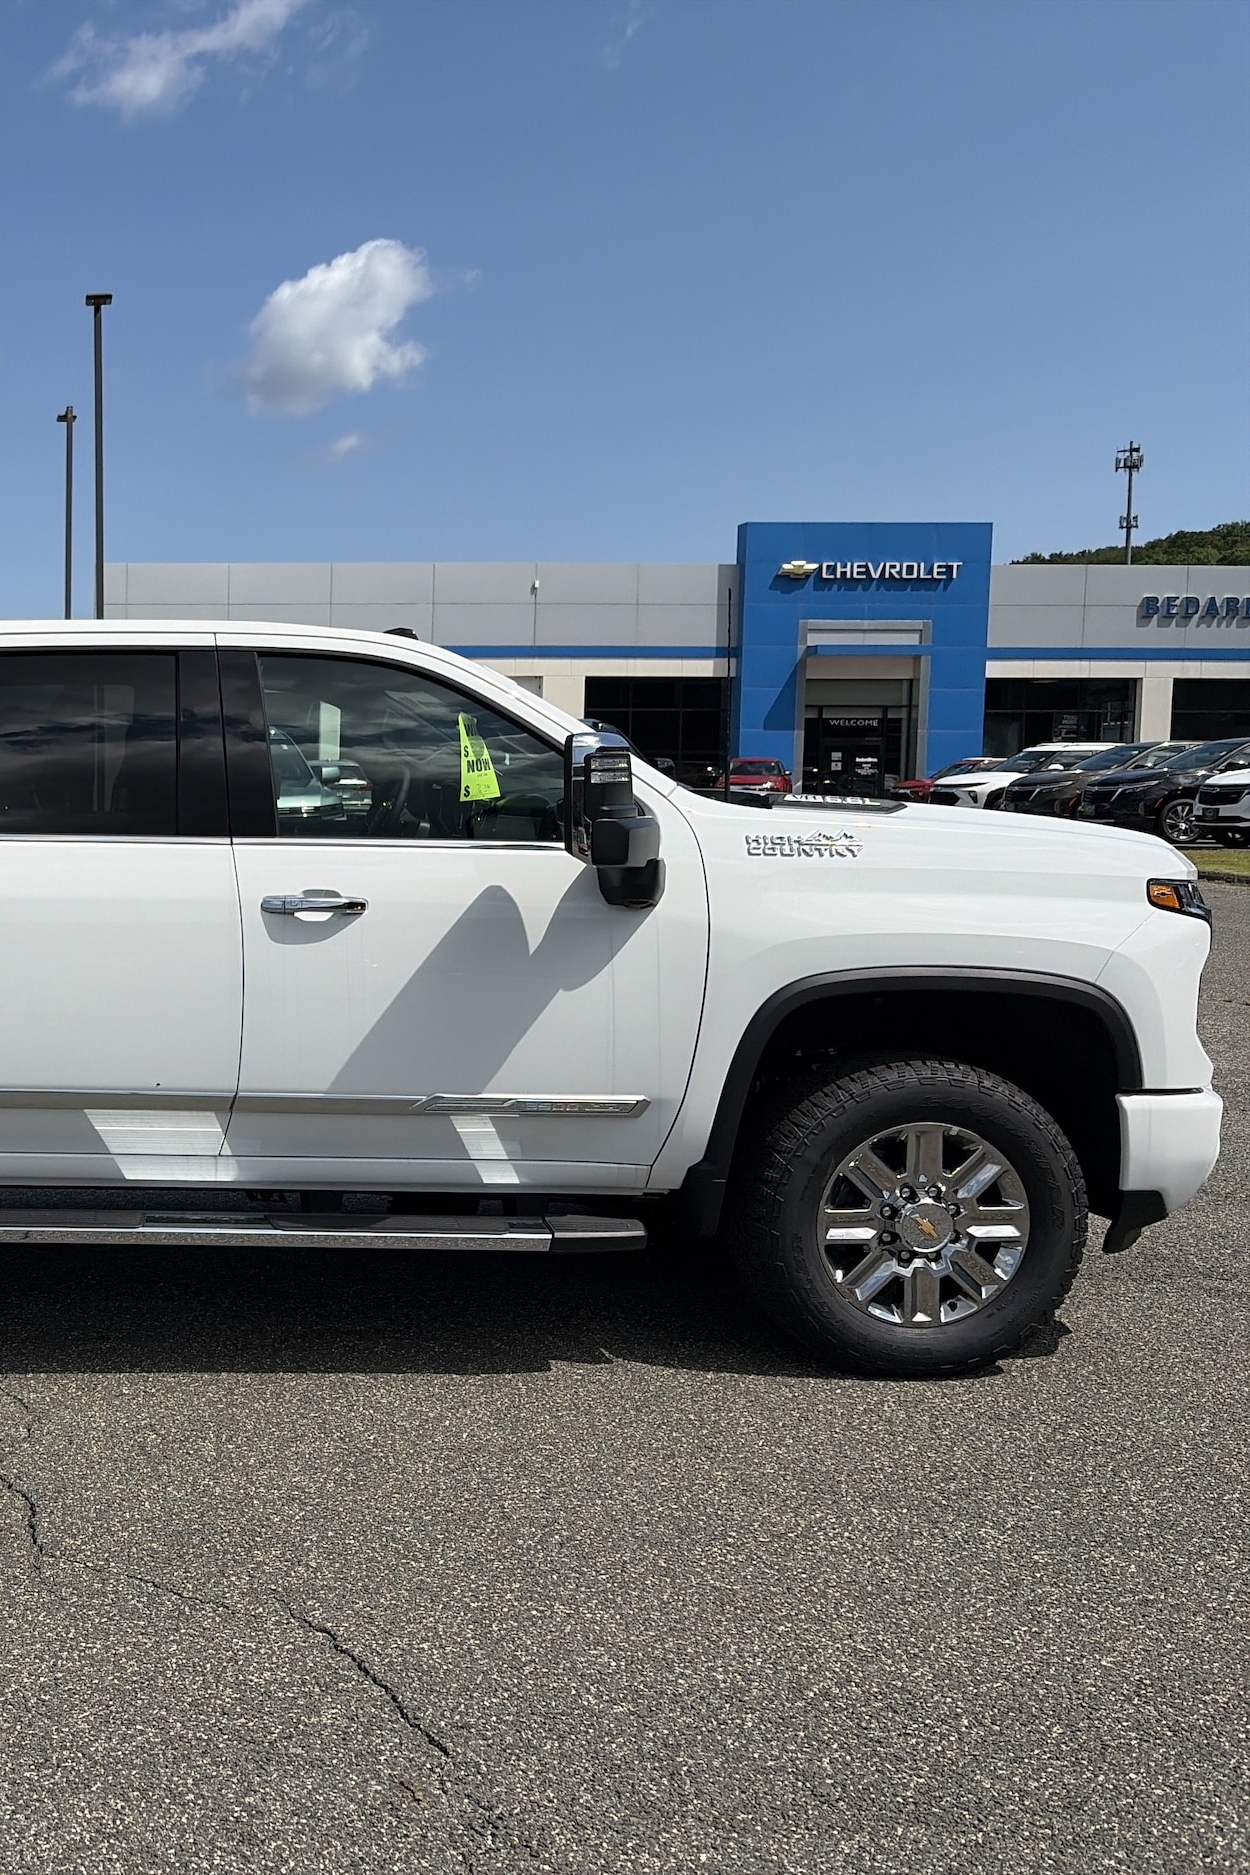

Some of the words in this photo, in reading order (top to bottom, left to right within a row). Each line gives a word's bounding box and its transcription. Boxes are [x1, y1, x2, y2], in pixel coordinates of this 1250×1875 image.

[821, 562, 963, 579] CHEVROLET
[1143, 596, 1250, 616] BEDAR
[829, 719, 879, 727] WELCOME
[466, 758, 491, 773] NOW
[463, 784, 471, 798] $
[745, 835, 804, 846] HIGH
[747, 845, 863, 857] COUNTRY
